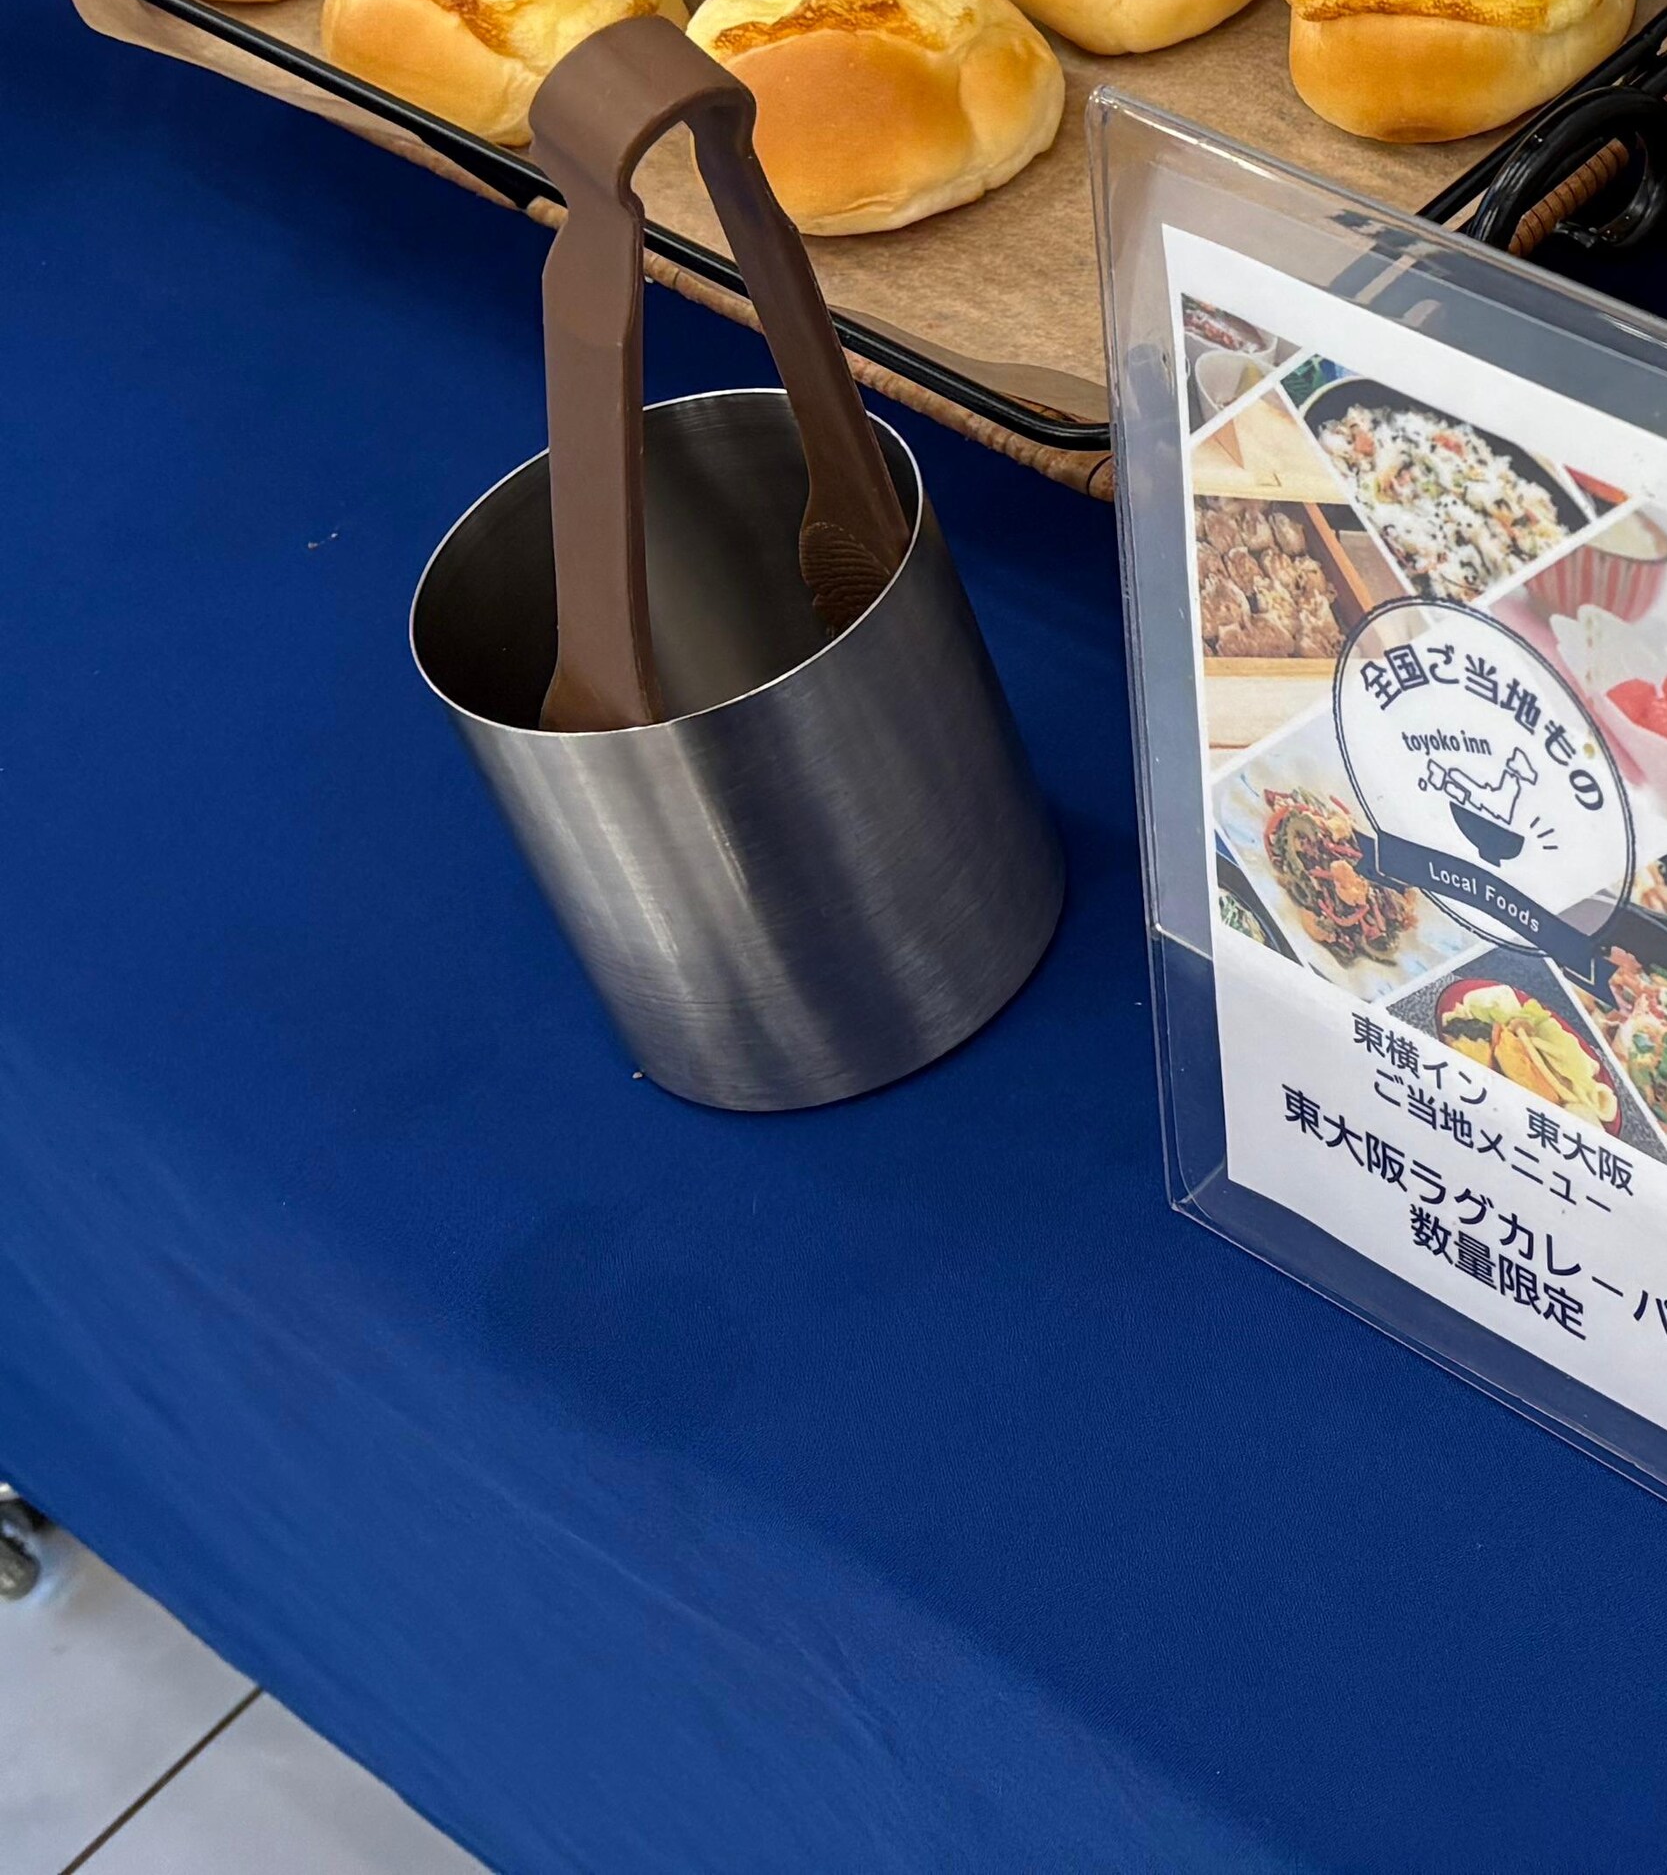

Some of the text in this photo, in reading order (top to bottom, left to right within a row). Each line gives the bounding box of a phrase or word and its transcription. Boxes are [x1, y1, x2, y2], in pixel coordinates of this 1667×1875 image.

[1360, 644, 1604, 811] 全国ご当地もの
[1401, 728, 1492, 756] toyoko inn
[1429, 862, 1540, 933] Local Foods
[1352, 1012, 1635, 1196] 東横イン 東大阪
[1373, 1069, 1612, 1213] ご当地メニュー
[1409, 1205, 1587, 1341] 数量限定
